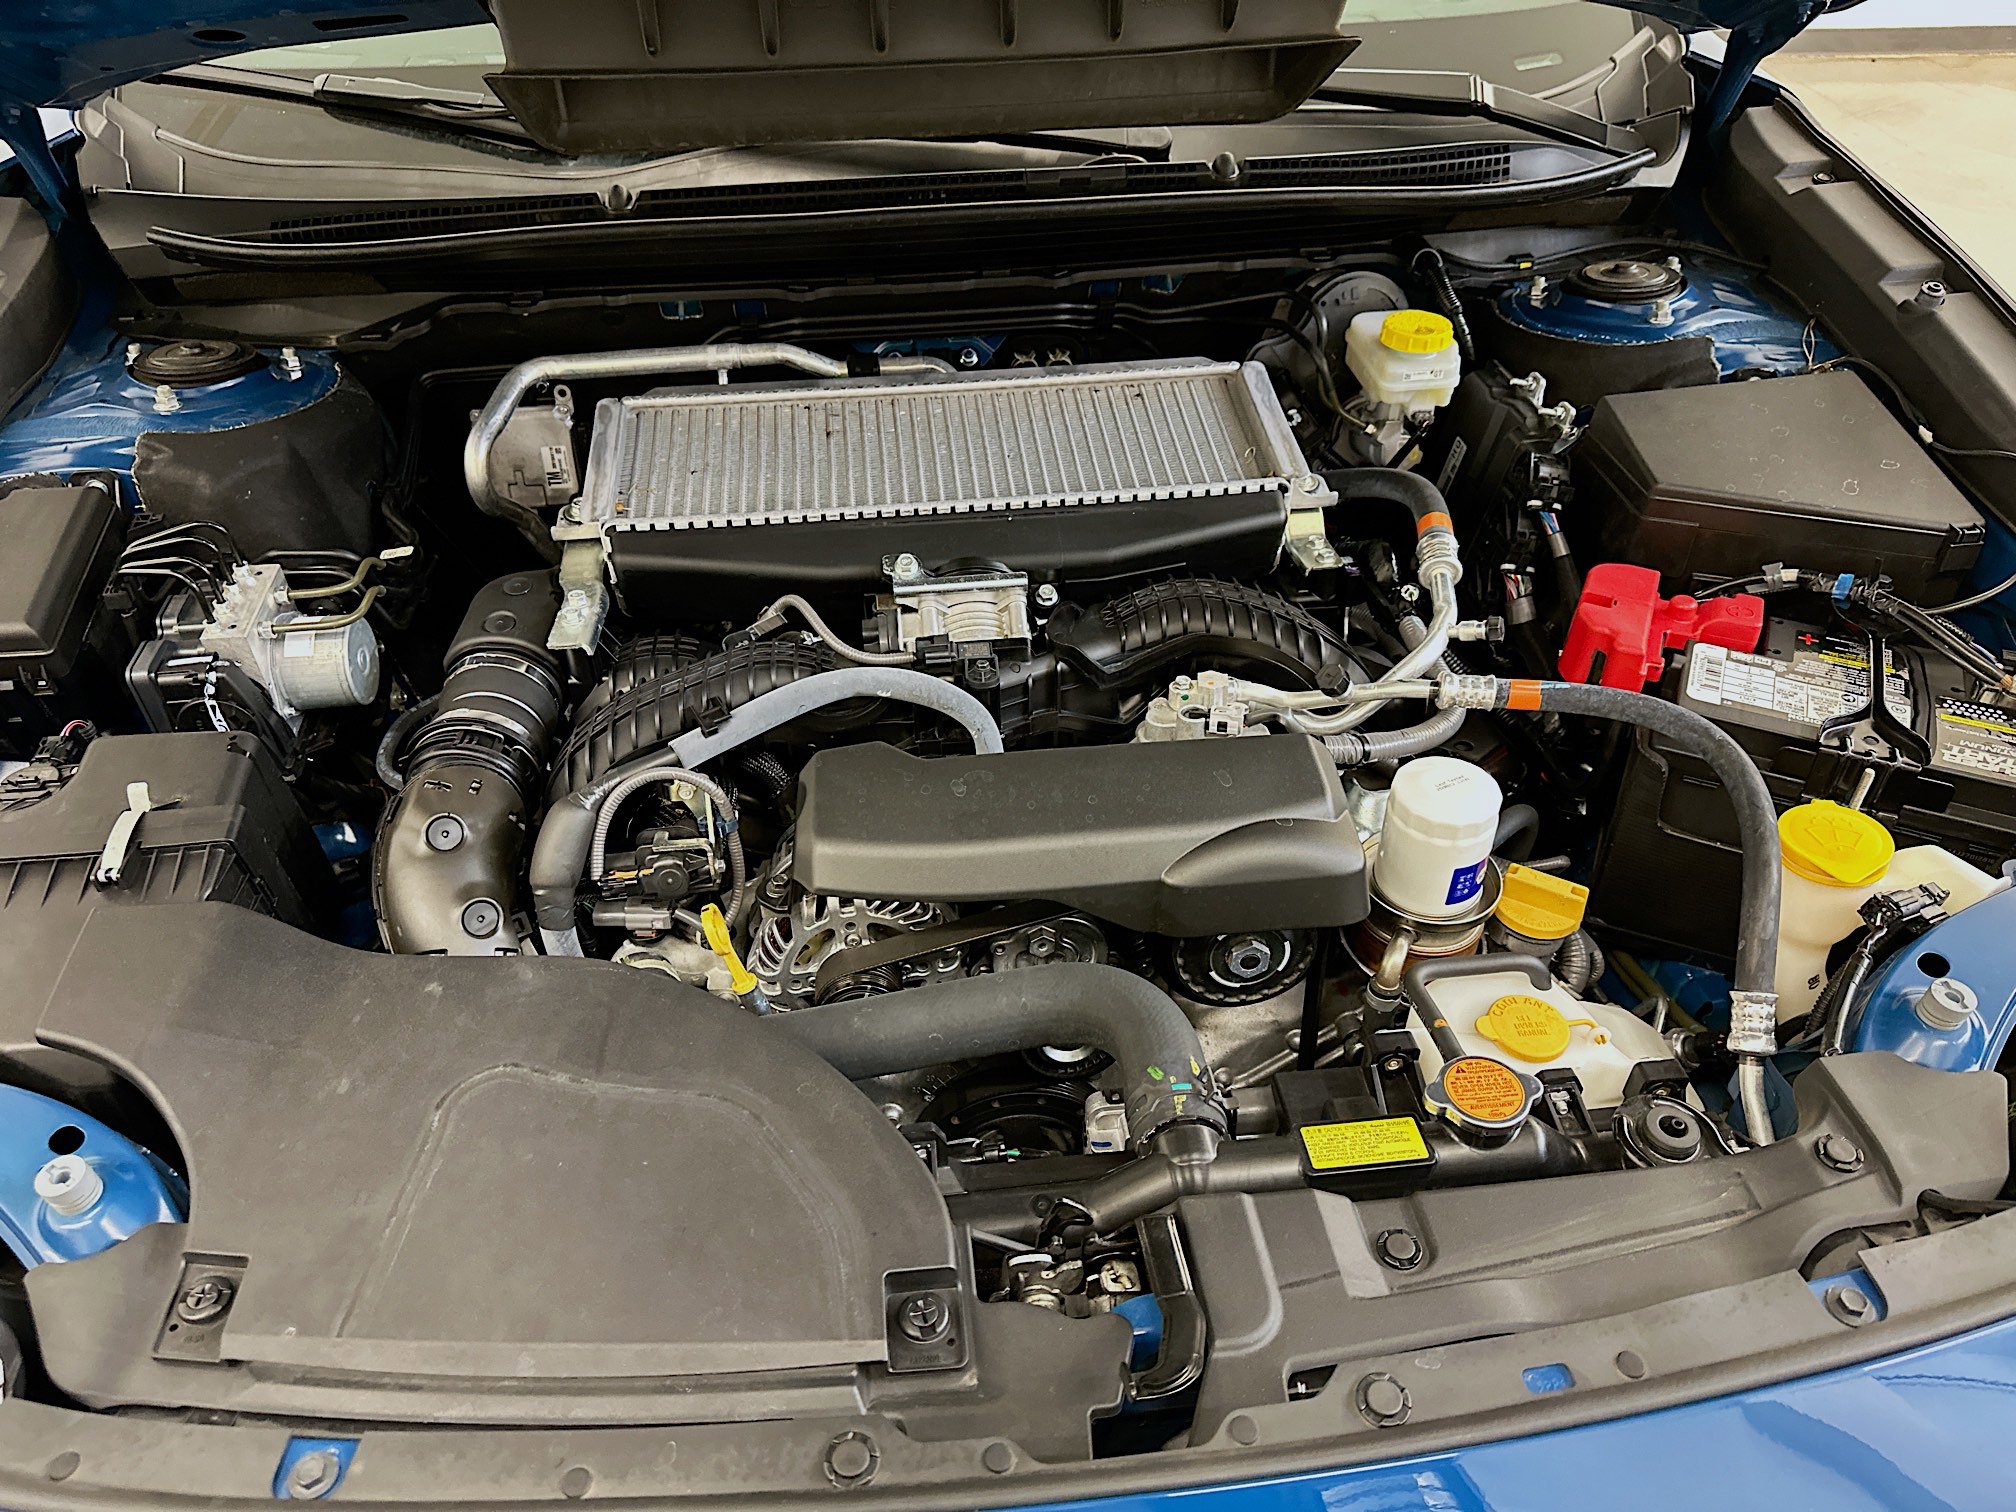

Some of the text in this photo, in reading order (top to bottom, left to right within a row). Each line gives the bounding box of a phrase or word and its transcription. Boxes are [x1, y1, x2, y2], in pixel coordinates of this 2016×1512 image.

[546, 471, 562, 487] TM
[1787, 713, 1823, 725] OISON
[1939, 745, 2016, 767] TART
[1959, 739, 2016, 756] ATINUM
[1942, 752, 2016, 776] UPER
